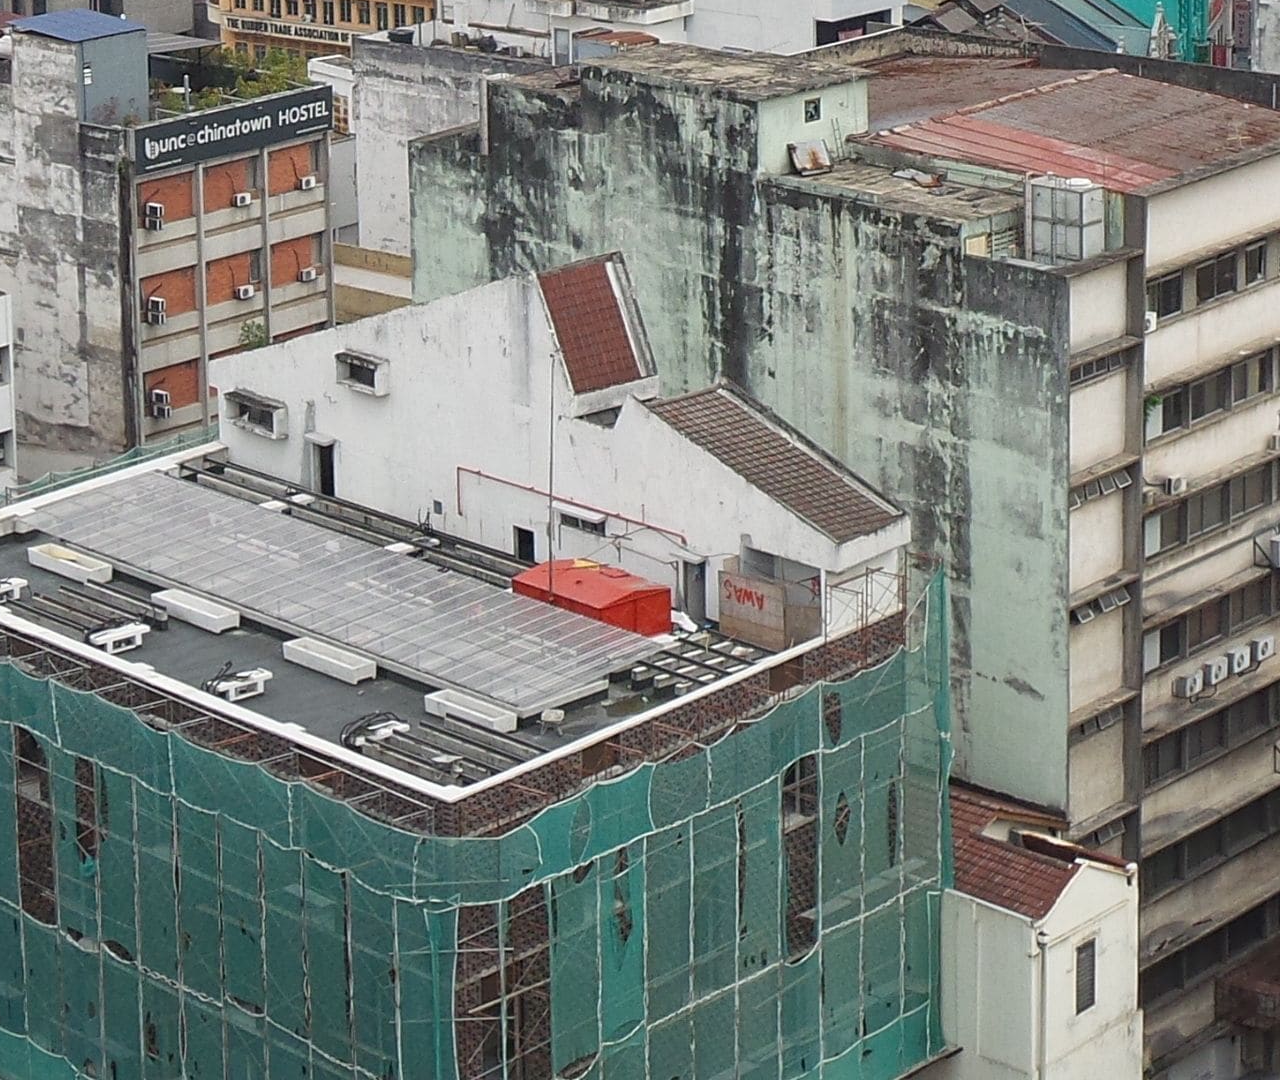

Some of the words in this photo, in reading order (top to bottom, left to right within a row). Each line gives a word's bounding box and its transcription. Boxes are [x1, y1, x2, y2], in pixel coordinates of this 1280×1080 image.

[226, 17, 239, 29] THE
[270, 23, 293, 36] TRADE
[294, 26, 339, 41] ASSOCIATION
[278, 100, 329, 127] HOSTEL
